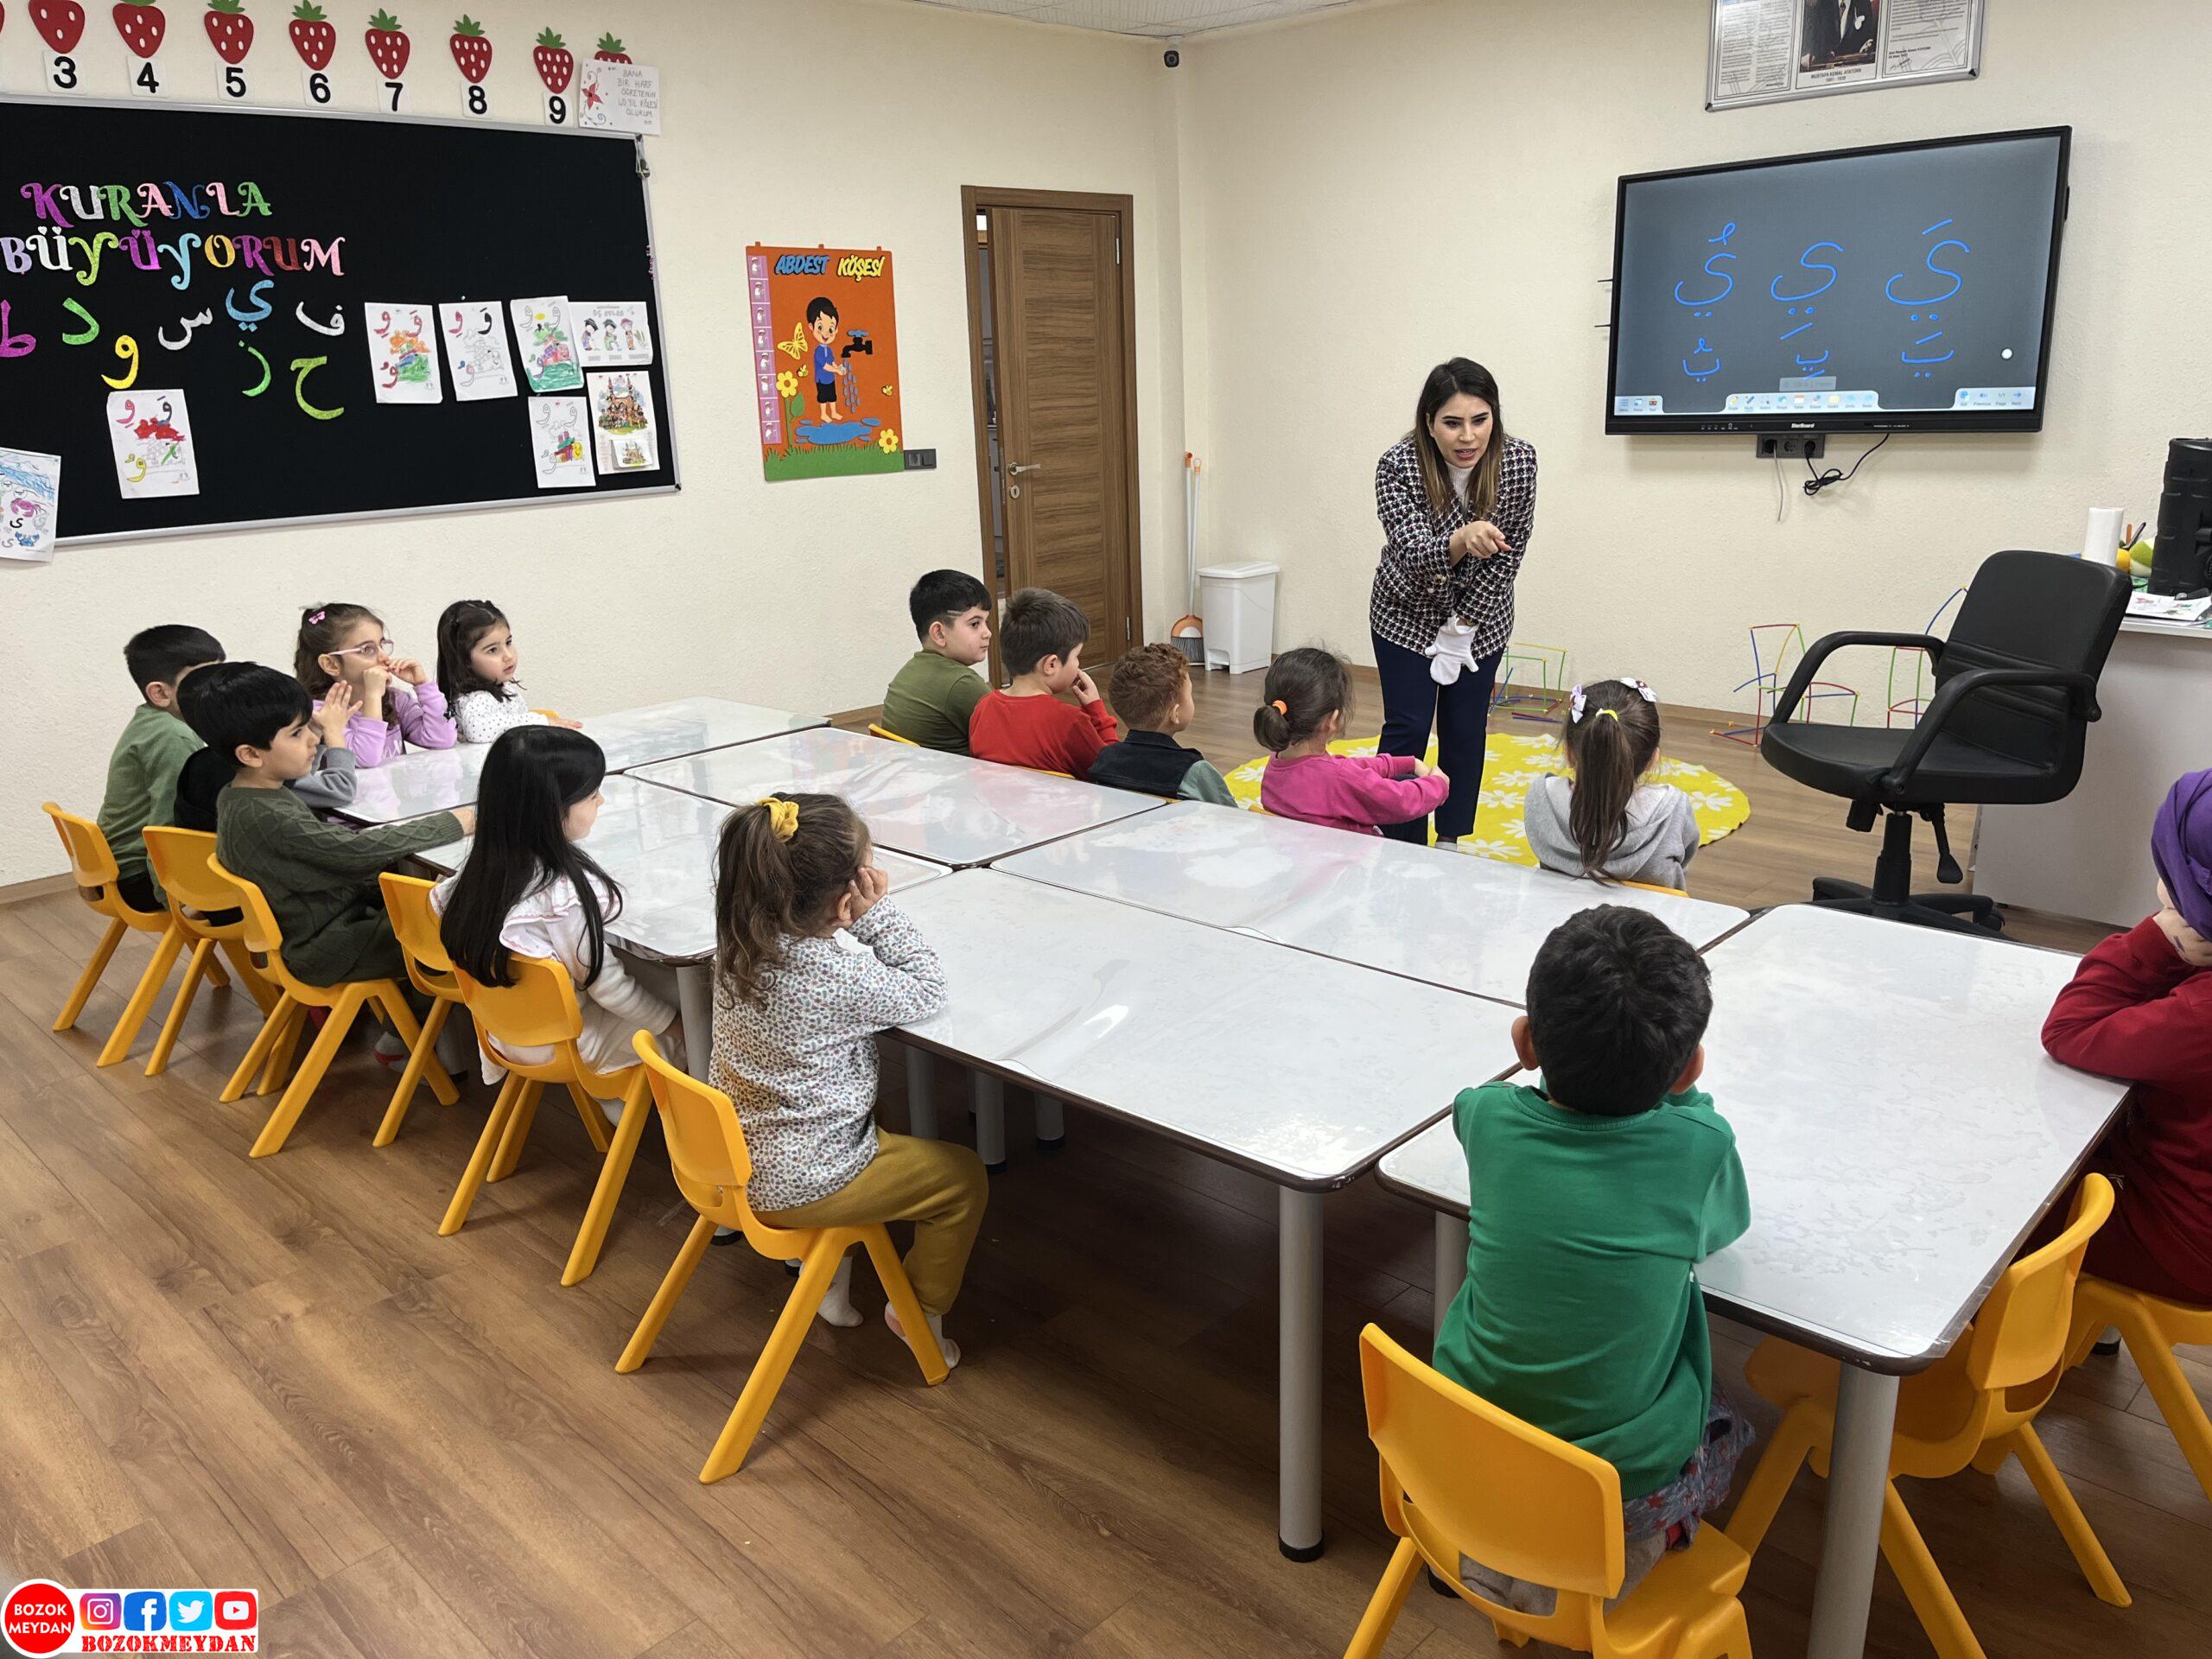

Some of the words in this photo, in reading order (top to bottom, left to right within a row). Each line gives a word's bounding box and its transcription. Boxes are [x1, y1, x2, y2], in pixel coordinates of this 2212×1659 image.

[53, 56, 78, 89] 3
[136, 61, 160, 93] 4
[226, 67, 247, 98] 5
[622, 69, 643, 78] BANA
[308, 73, 332, 104] 6
[385, 82, 404, 111] 7
[468, 85, 487, 115] 8
[549, 95, 567, 124] 9
[20, 181, 273, 228] KURANLA
[774, 254, 830, 276] ABDEST
